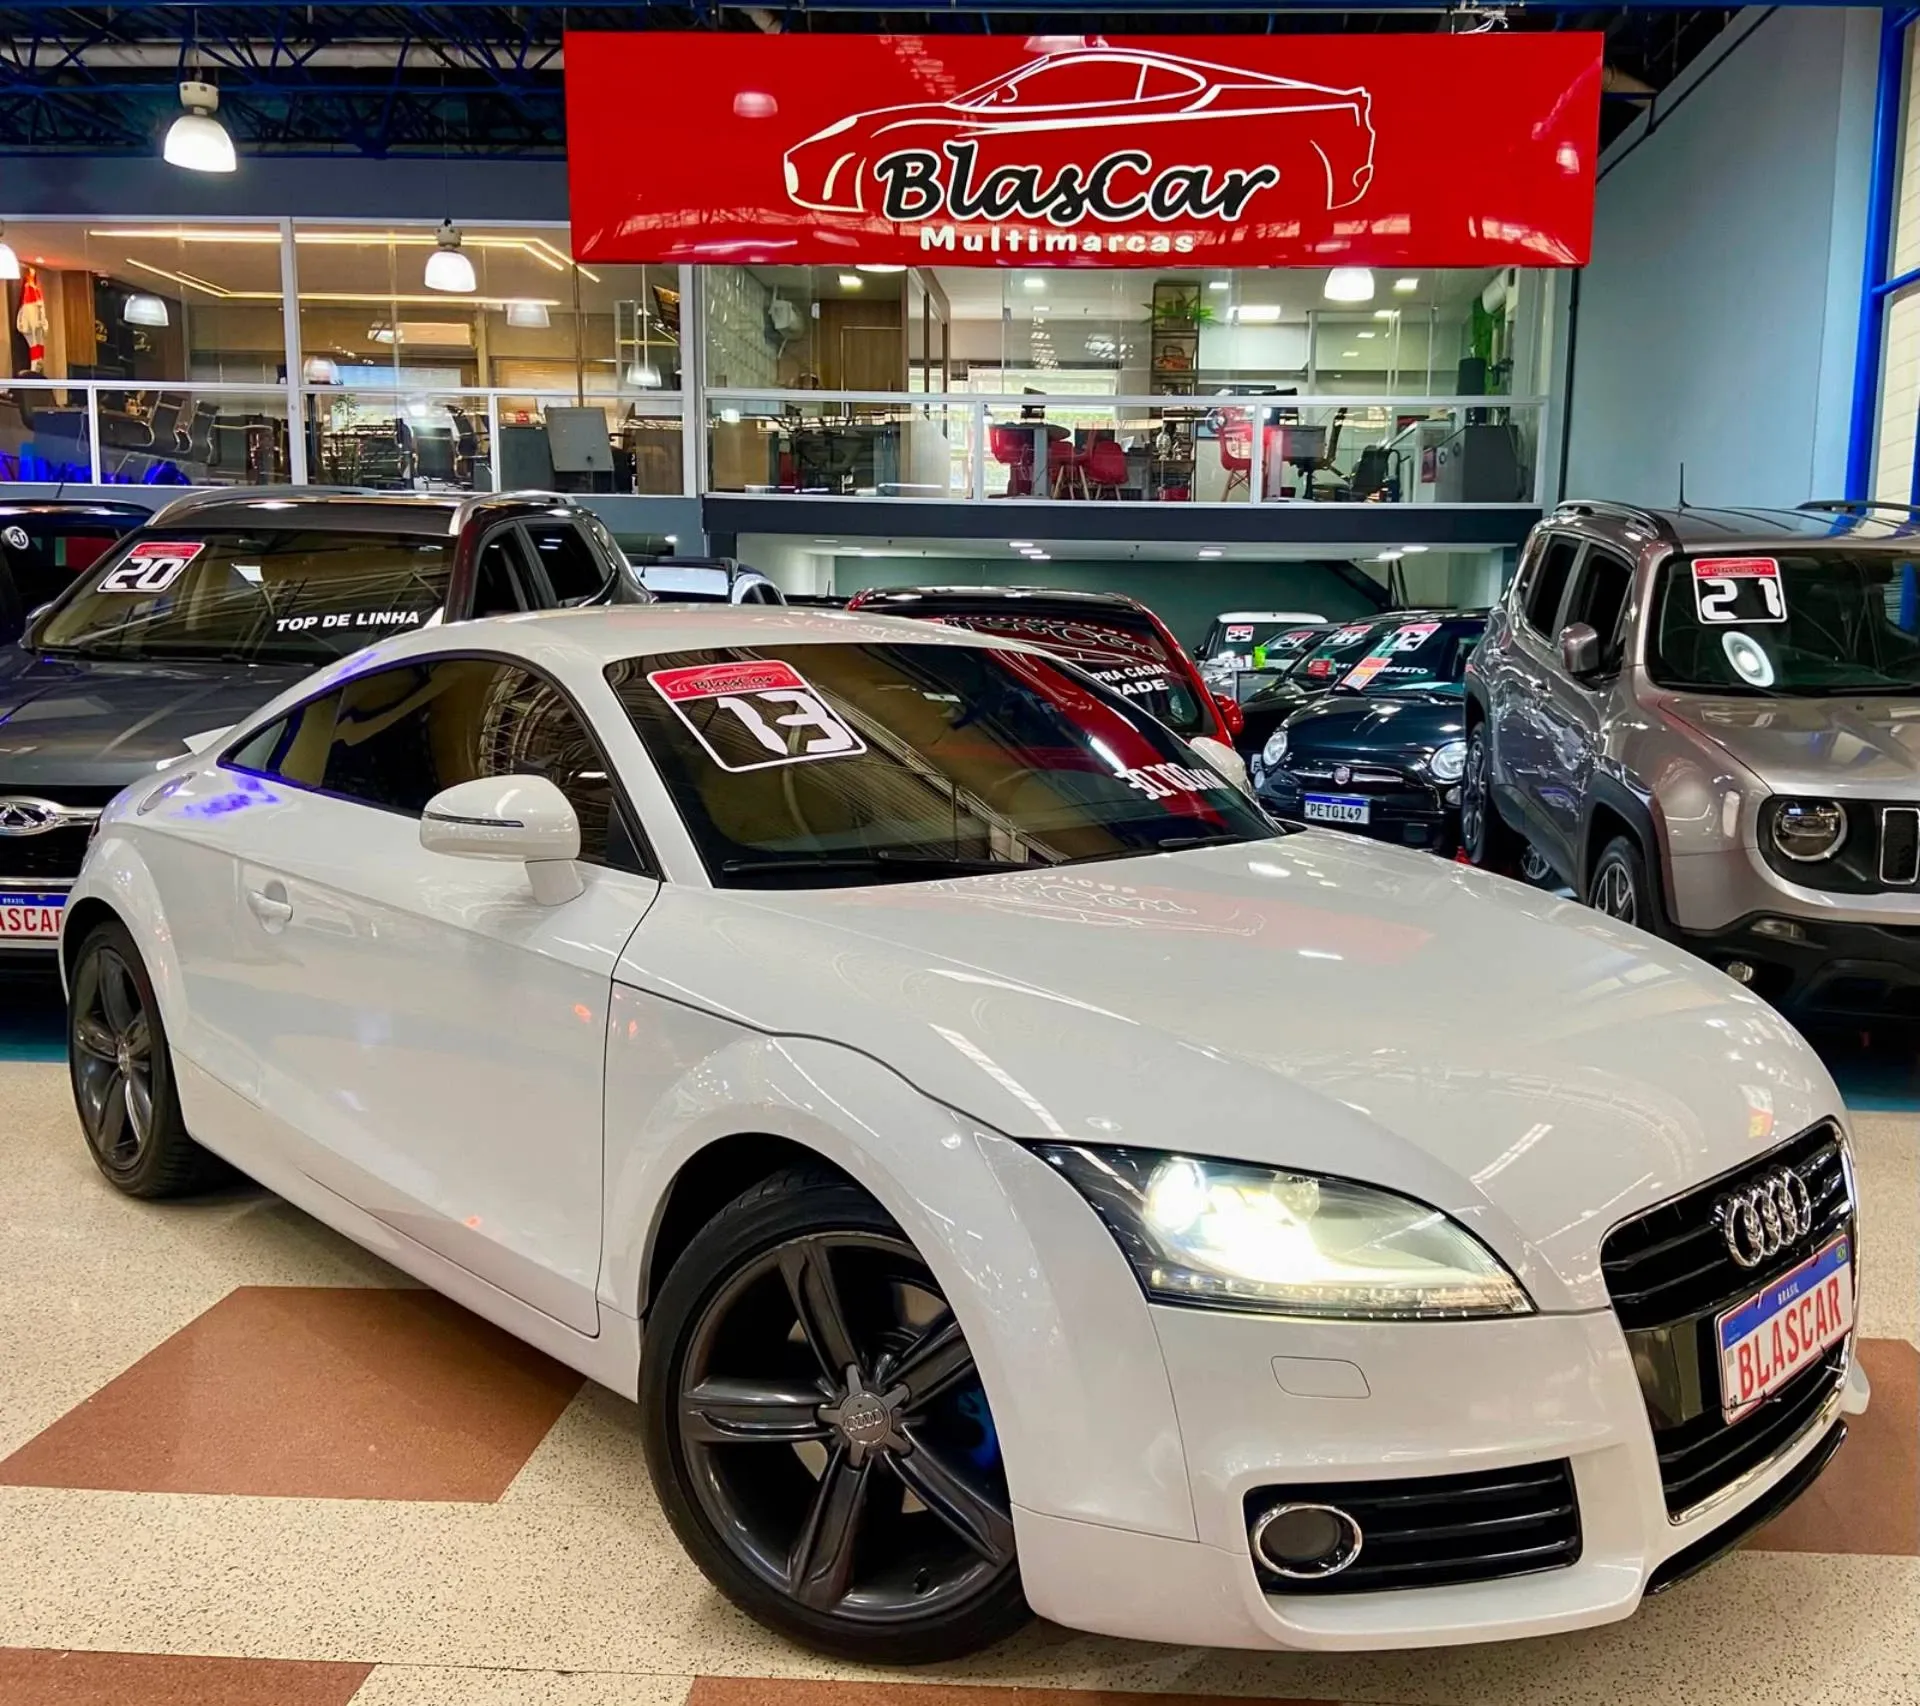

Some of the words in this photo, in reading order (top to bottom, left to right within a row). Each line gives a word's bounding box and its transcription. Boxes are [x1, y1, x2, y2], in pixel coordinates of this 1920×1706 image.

[874, 140, 1280, 226] BlasCar
[919, 225, 1195, 254] Multimarcas
[104, 558, 185, 589] 20
[1702, 578, 1782, 620] 21
[276, 615, 319, 632] TOP
[322, 613, 351, 628] DE
[356, 611, 419, 626] LINHA
[716, 690, 854, 756] 13
[1738, 1277, 1842, 1401] BLASCAR
